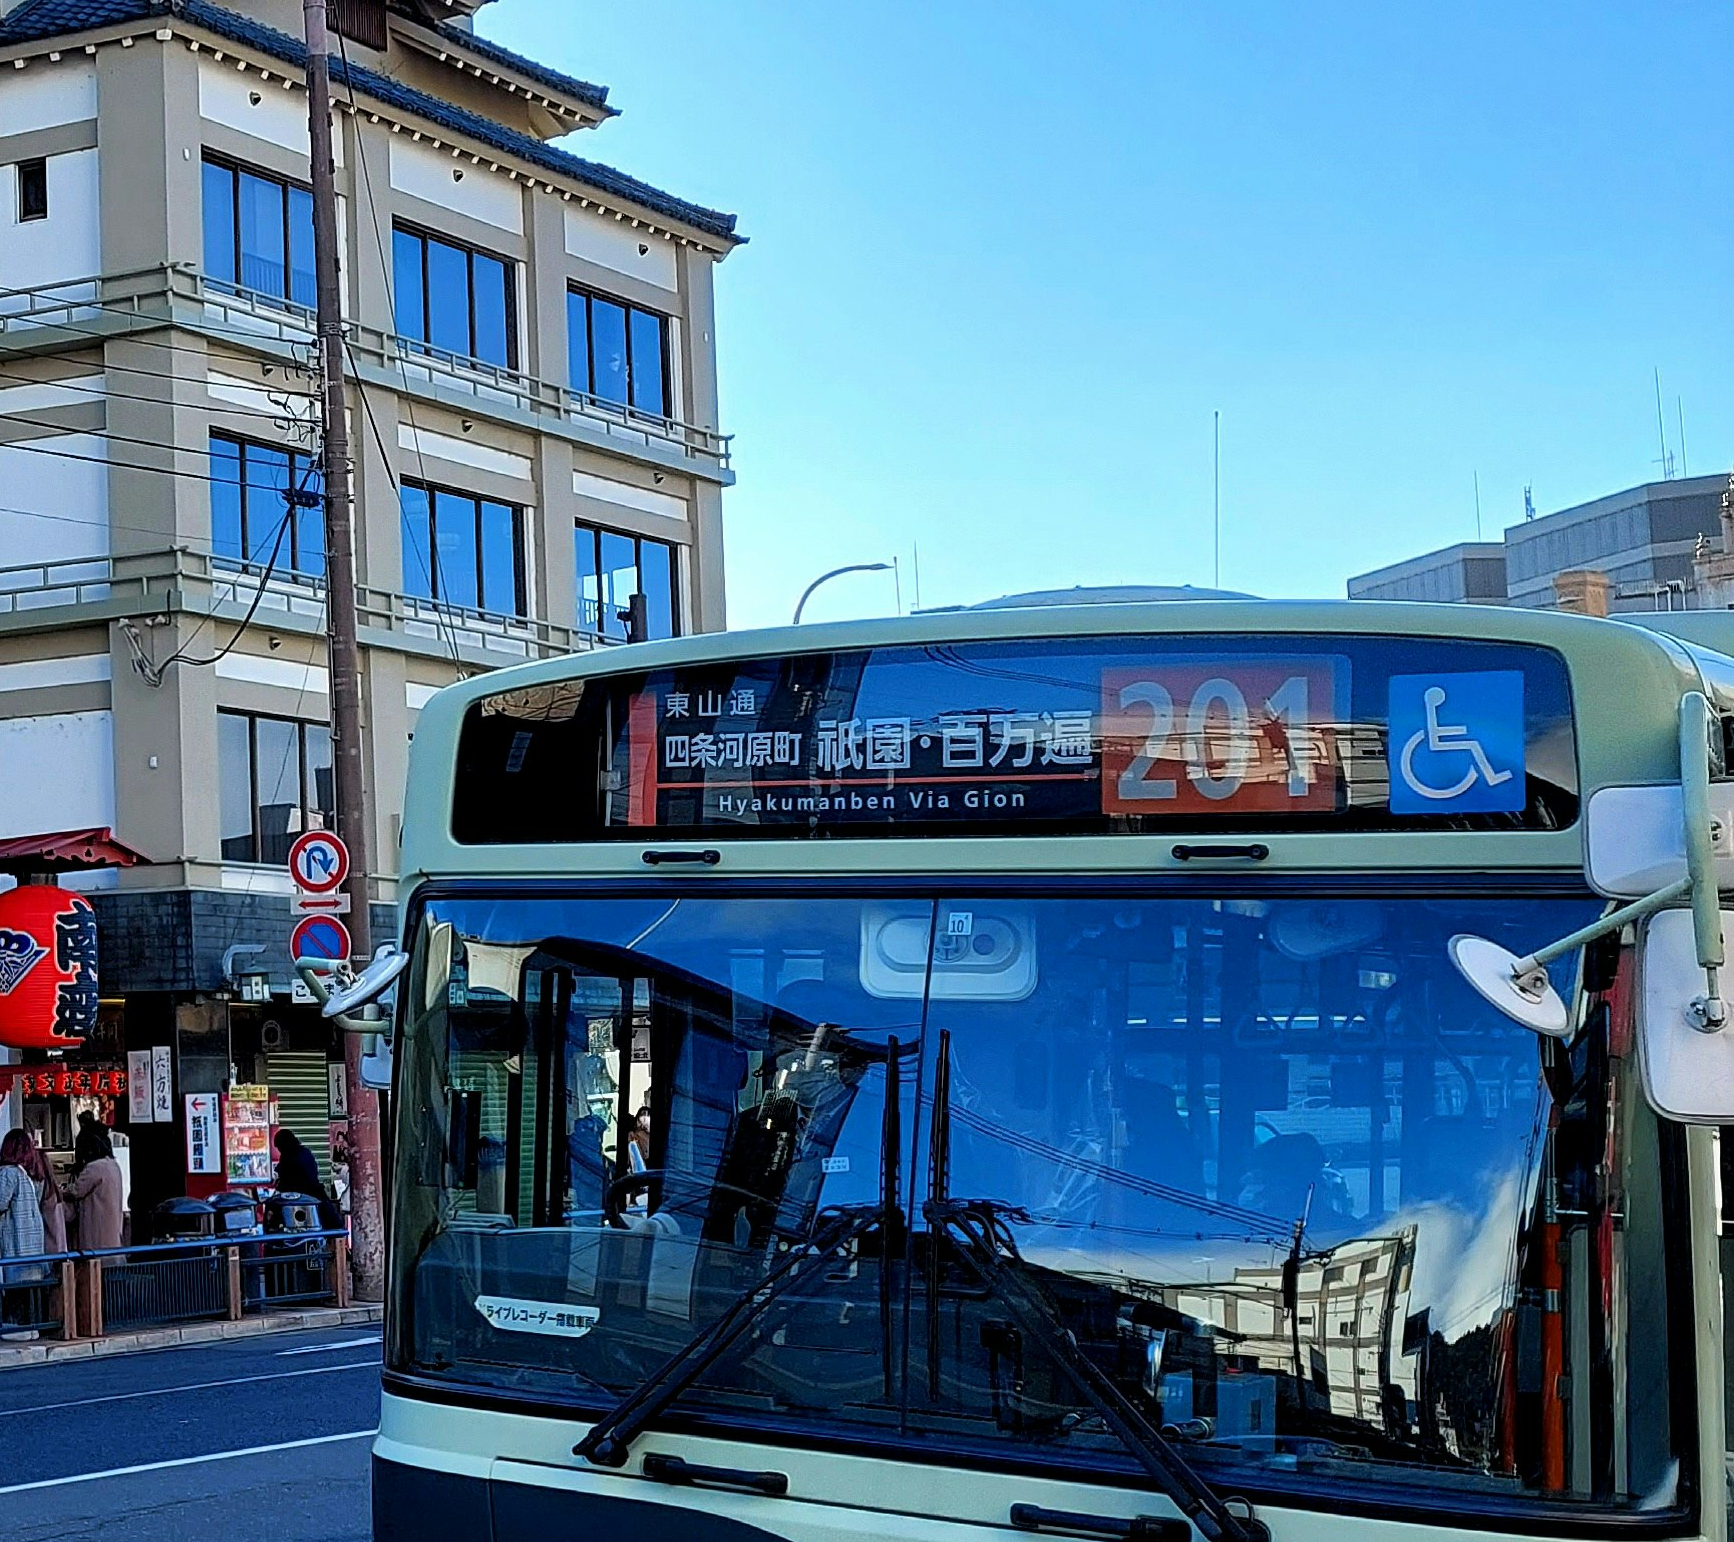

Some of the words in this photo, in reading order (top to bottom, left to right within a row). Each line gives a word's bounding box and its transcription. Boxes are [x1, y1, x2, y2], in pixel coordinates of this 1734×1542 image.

[665, 689, 756, 718] 東山通
[665, 731, 802, 768] 四条河原町
[1118, 676, 1309, 801] 201
[718, 791, 896, 816] Hyakumanben
[908, 790, 950, 809] Via
[963, 789, 1026, 808] Gion
[950, 919, 964, 933] 10
